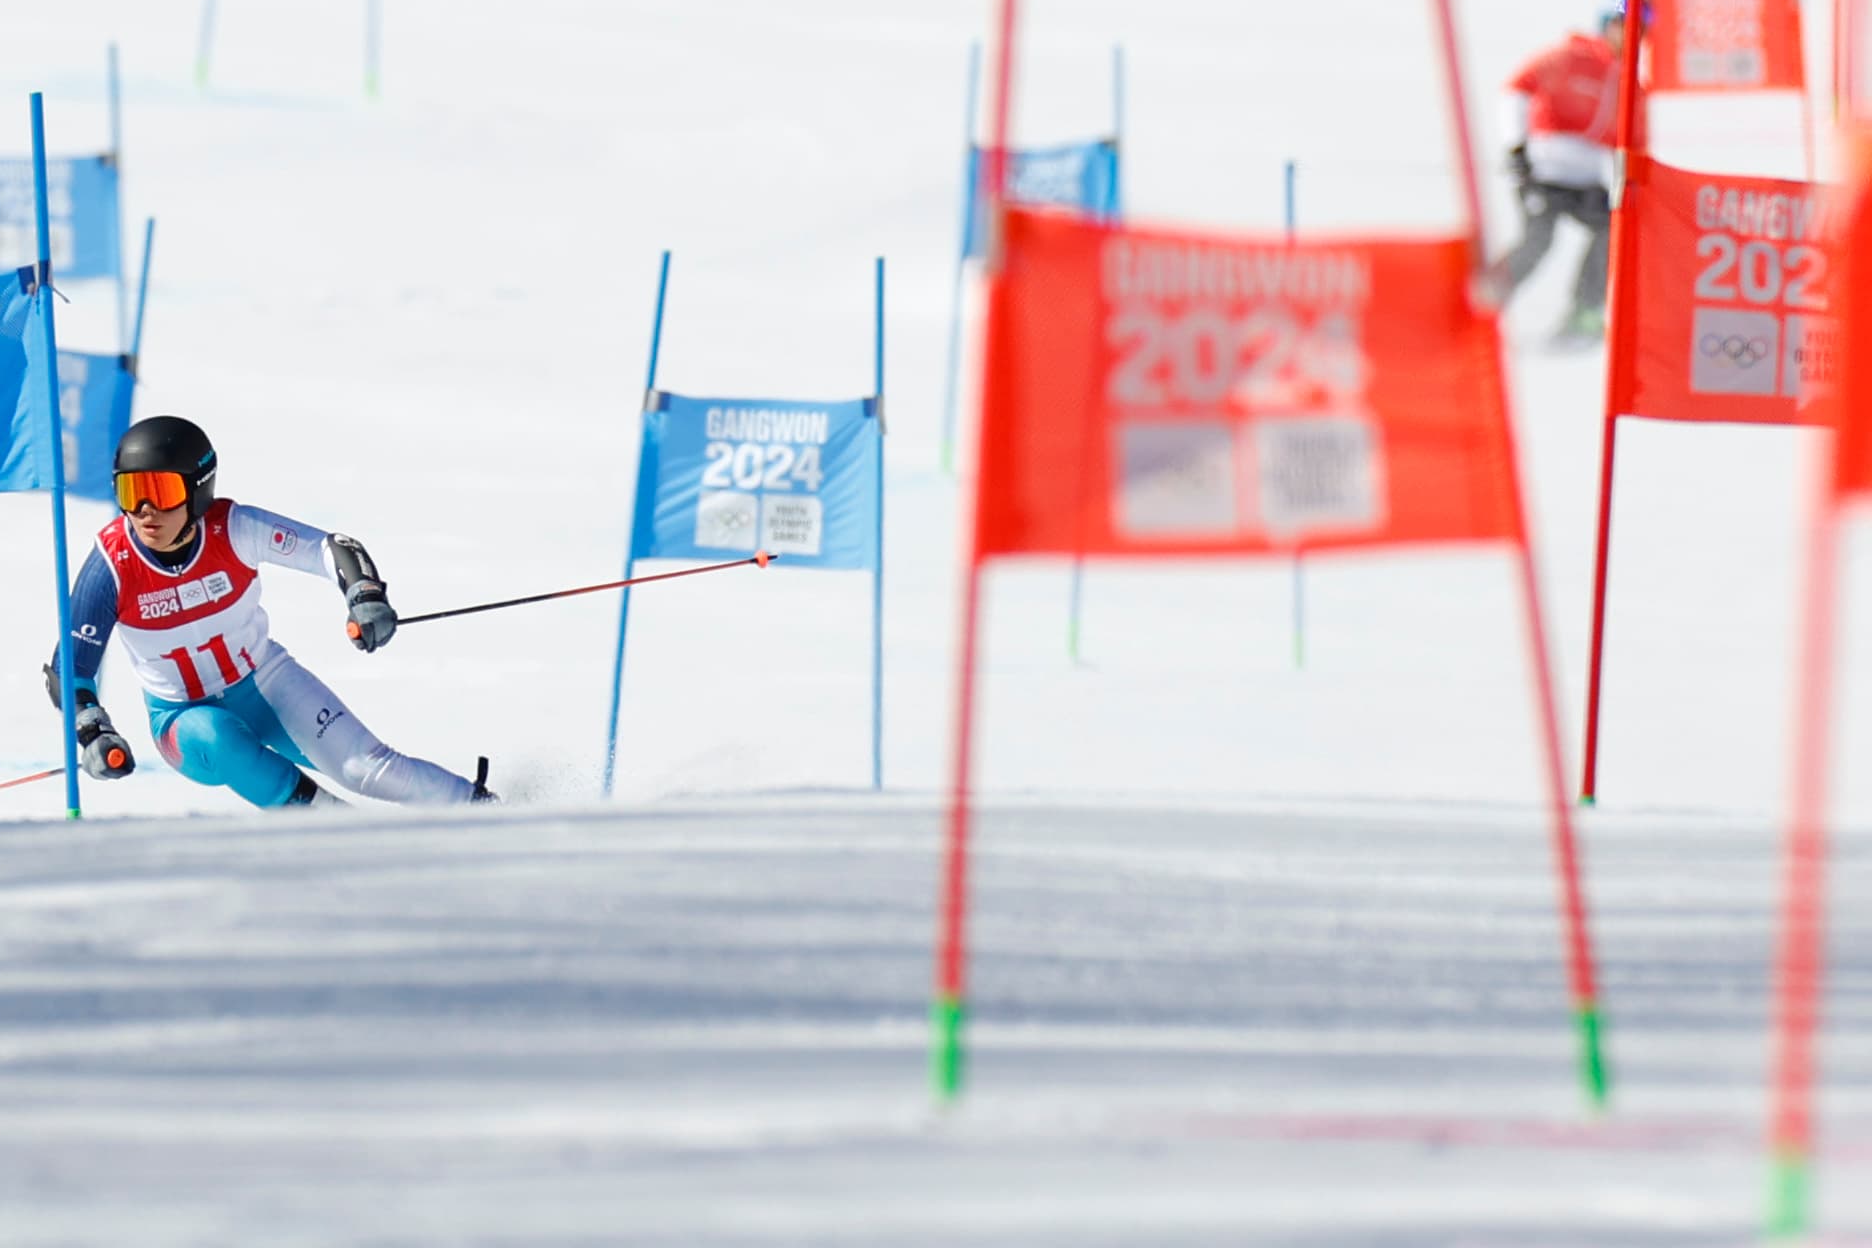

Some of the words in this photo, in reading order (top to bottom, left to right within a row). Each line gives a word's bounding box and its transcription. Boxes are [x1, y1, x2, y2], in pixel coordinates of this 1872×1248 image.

[1694, 233, 1828, 310] 202
[1105, 304, 1372, 414] 2024
[705, 407, 827, 444] GANGWON
[701, 440, 823, 491] 2024
[137, 587, 177, 605] GANGWON
[140, 598, 181, 620] 2024
